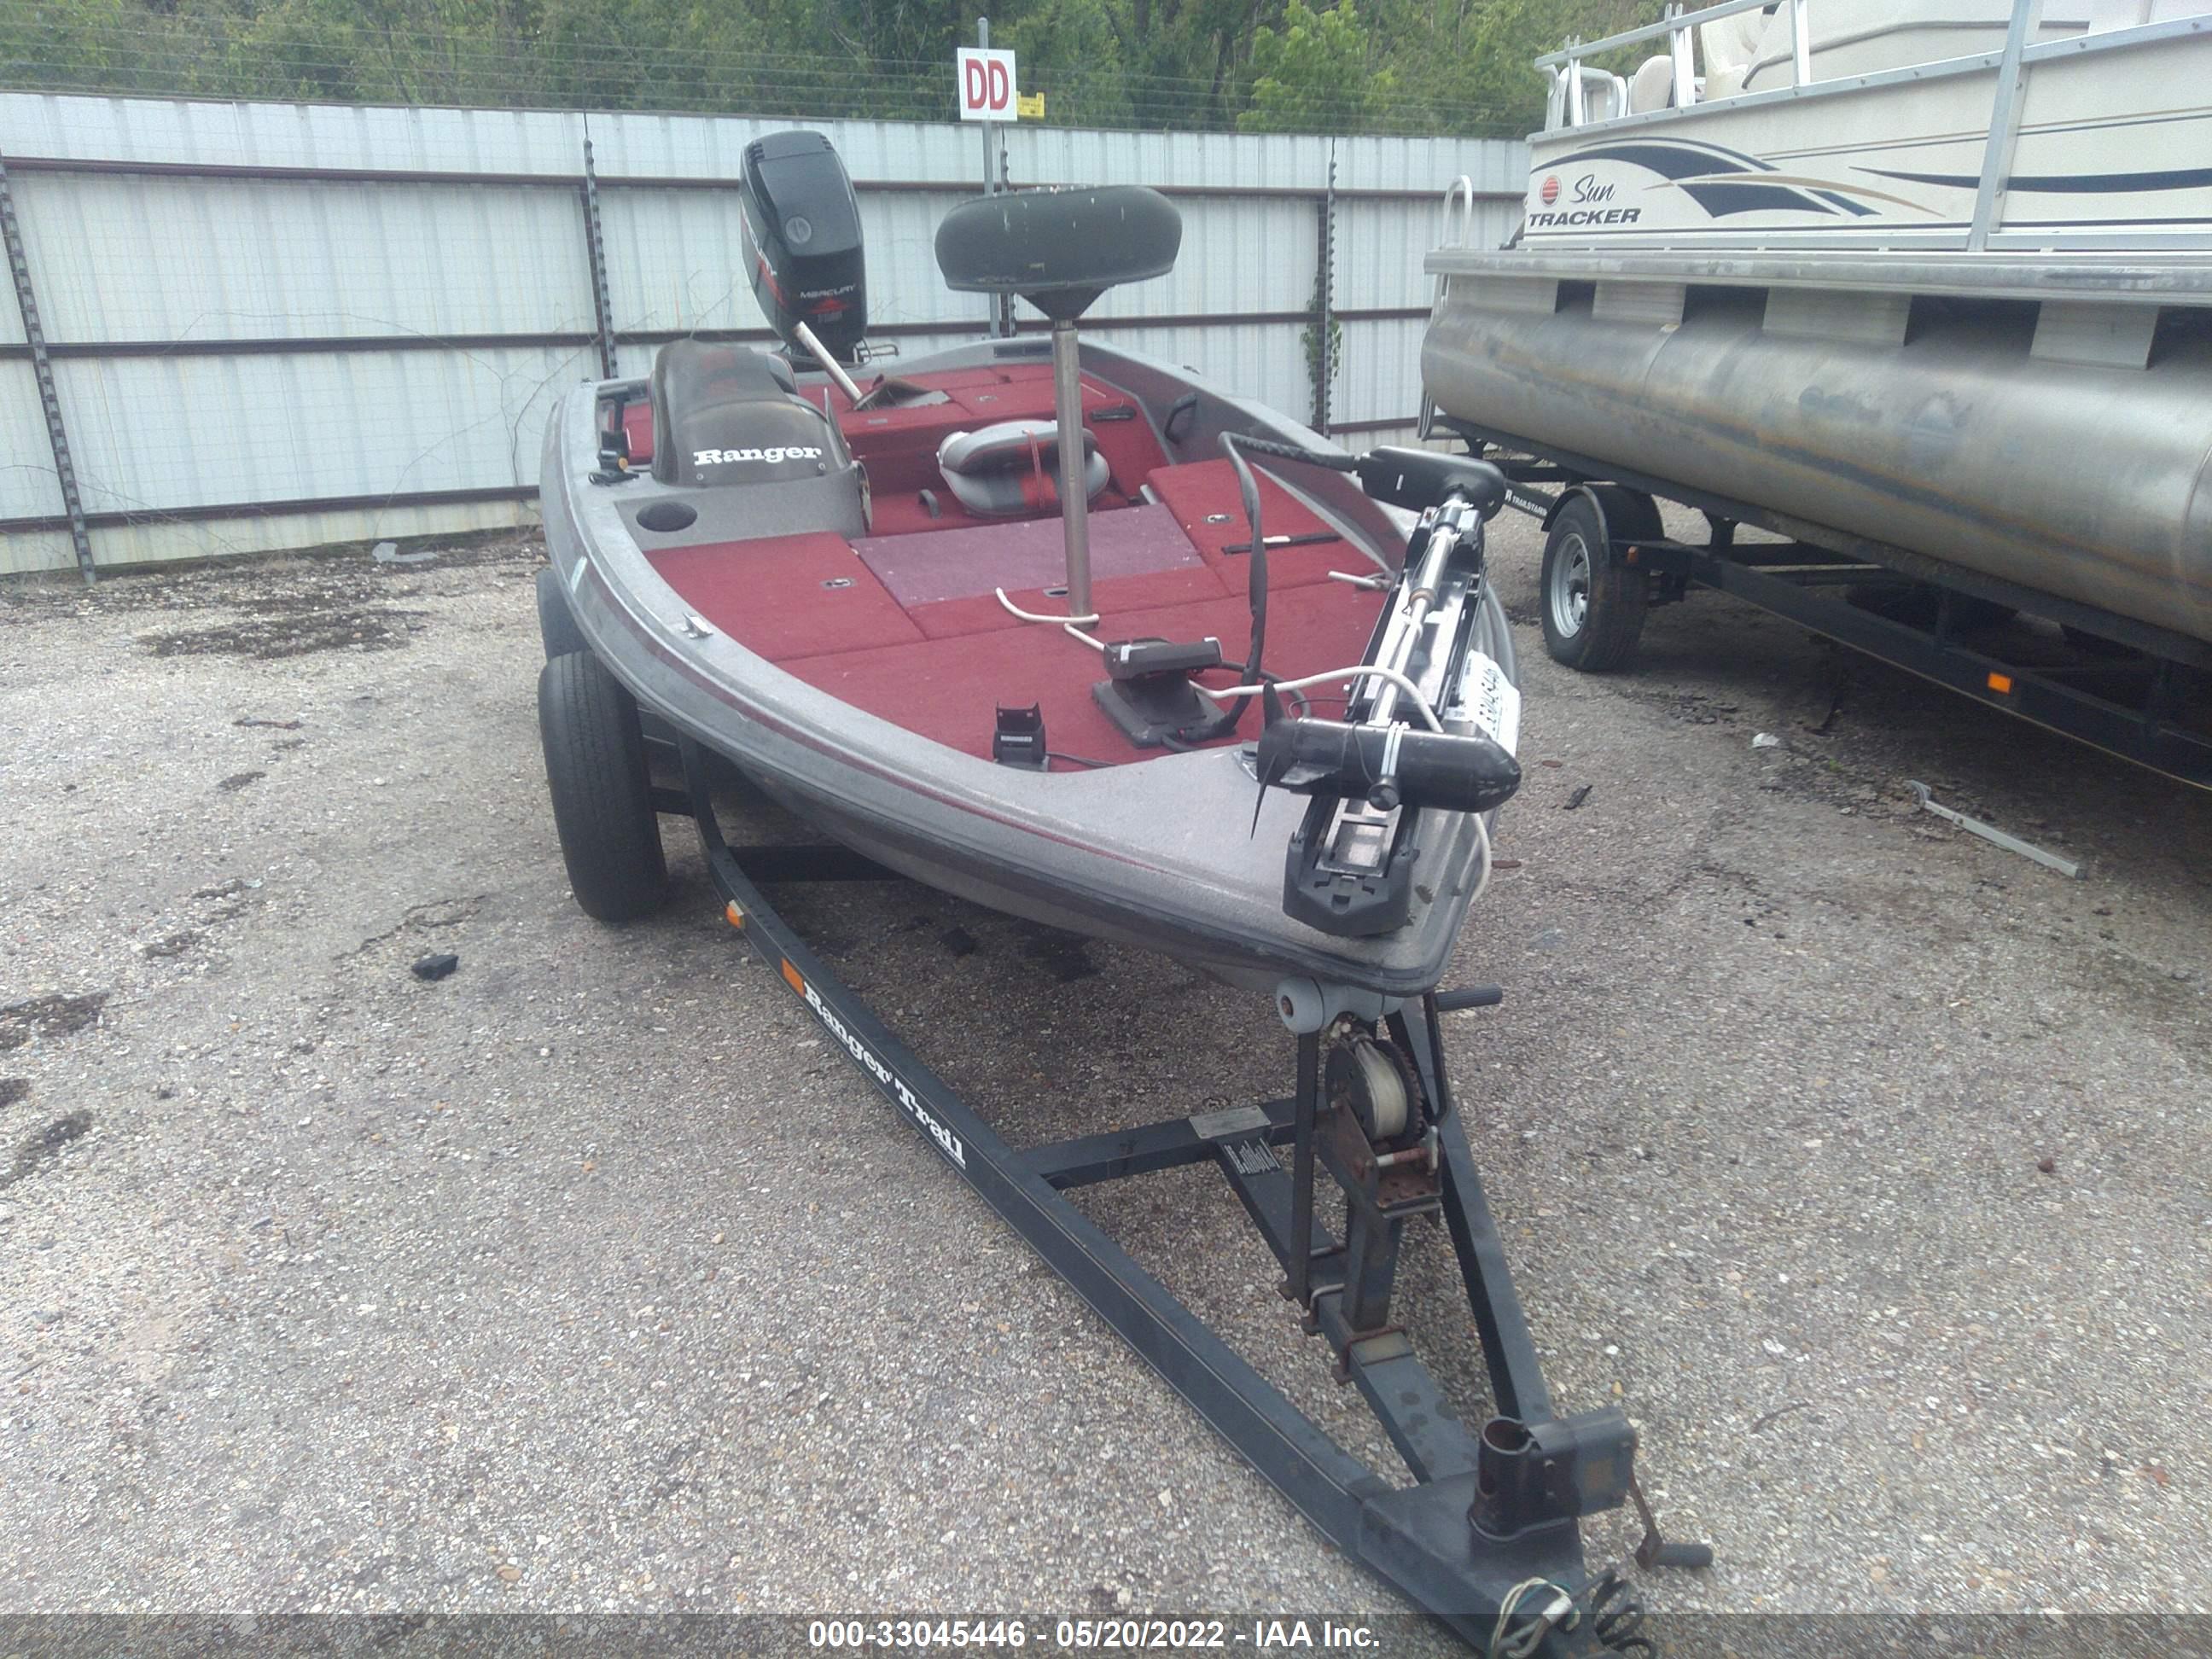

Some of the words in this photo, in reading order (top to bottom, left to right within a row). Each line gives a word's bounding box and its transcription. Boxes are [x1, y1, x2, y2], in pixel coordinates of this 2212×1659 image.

[965, 58, 1010, 110] DD
[1570, 174, 1615, 203] Sun
[1529, 208, 1641, 226] TRACKER
[800, 284, 855, 299] MERCURY
[693, 446, 822, 466] Ranger
[804, 981, 892, 1084] Ranger
[894, 1077, 966, 1166] Trail
